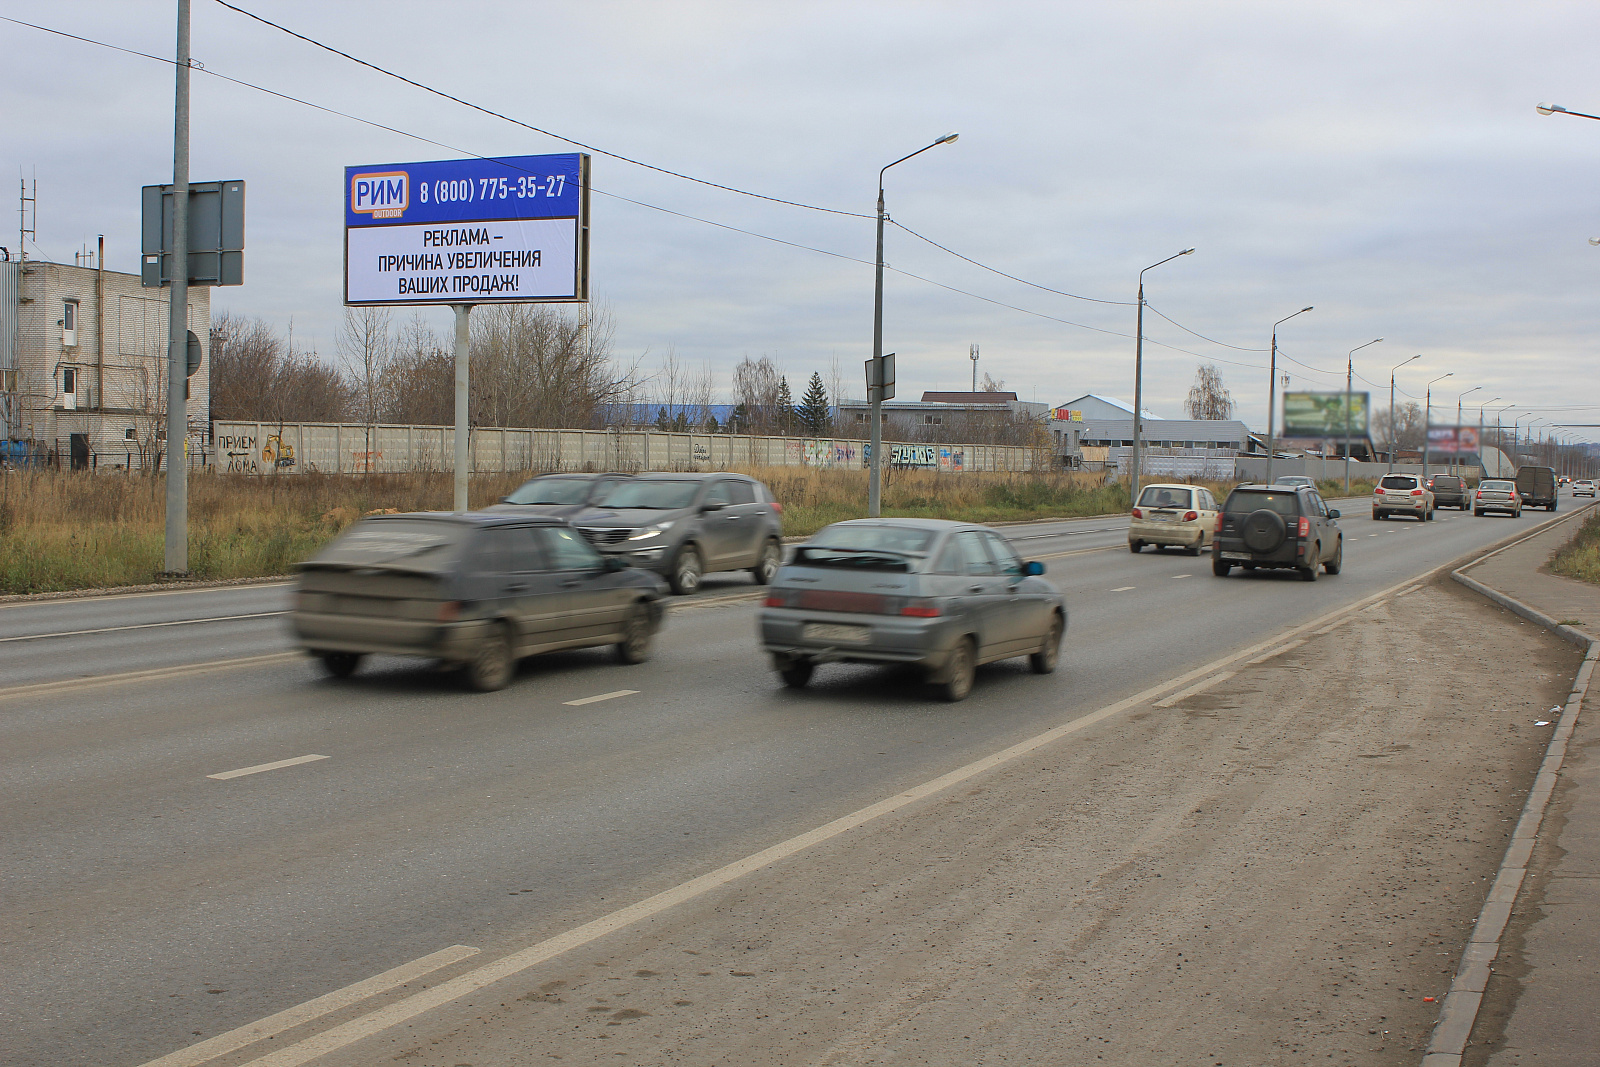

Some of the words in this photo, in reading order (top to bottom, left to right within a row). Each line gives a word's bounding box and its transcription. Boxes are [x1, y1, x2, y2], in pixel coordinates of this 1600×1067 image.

[357, 179, 404, 207] РИМ
[421, 182, 429, 204] 8
[434, 179, 475, 205] (800)
[480, 175, 566, 200] 775-35-27
[374, 209, 402, 218] OUTDOOR
[424, 229, 490, 247] РЕКЛАМА
[378, 253, 443, 272] ПРИЧИНА
[448, 250, 541, 270] УВЕЛИЧЕНИЯ
[398, 276, 448, 295] ВАШИХ
[453, 274, 519, 295] ПРОДАЖ!
[218, 436, 257, 449] ПРИЕМ
[227, 460, 257, 473] ЛОМА
